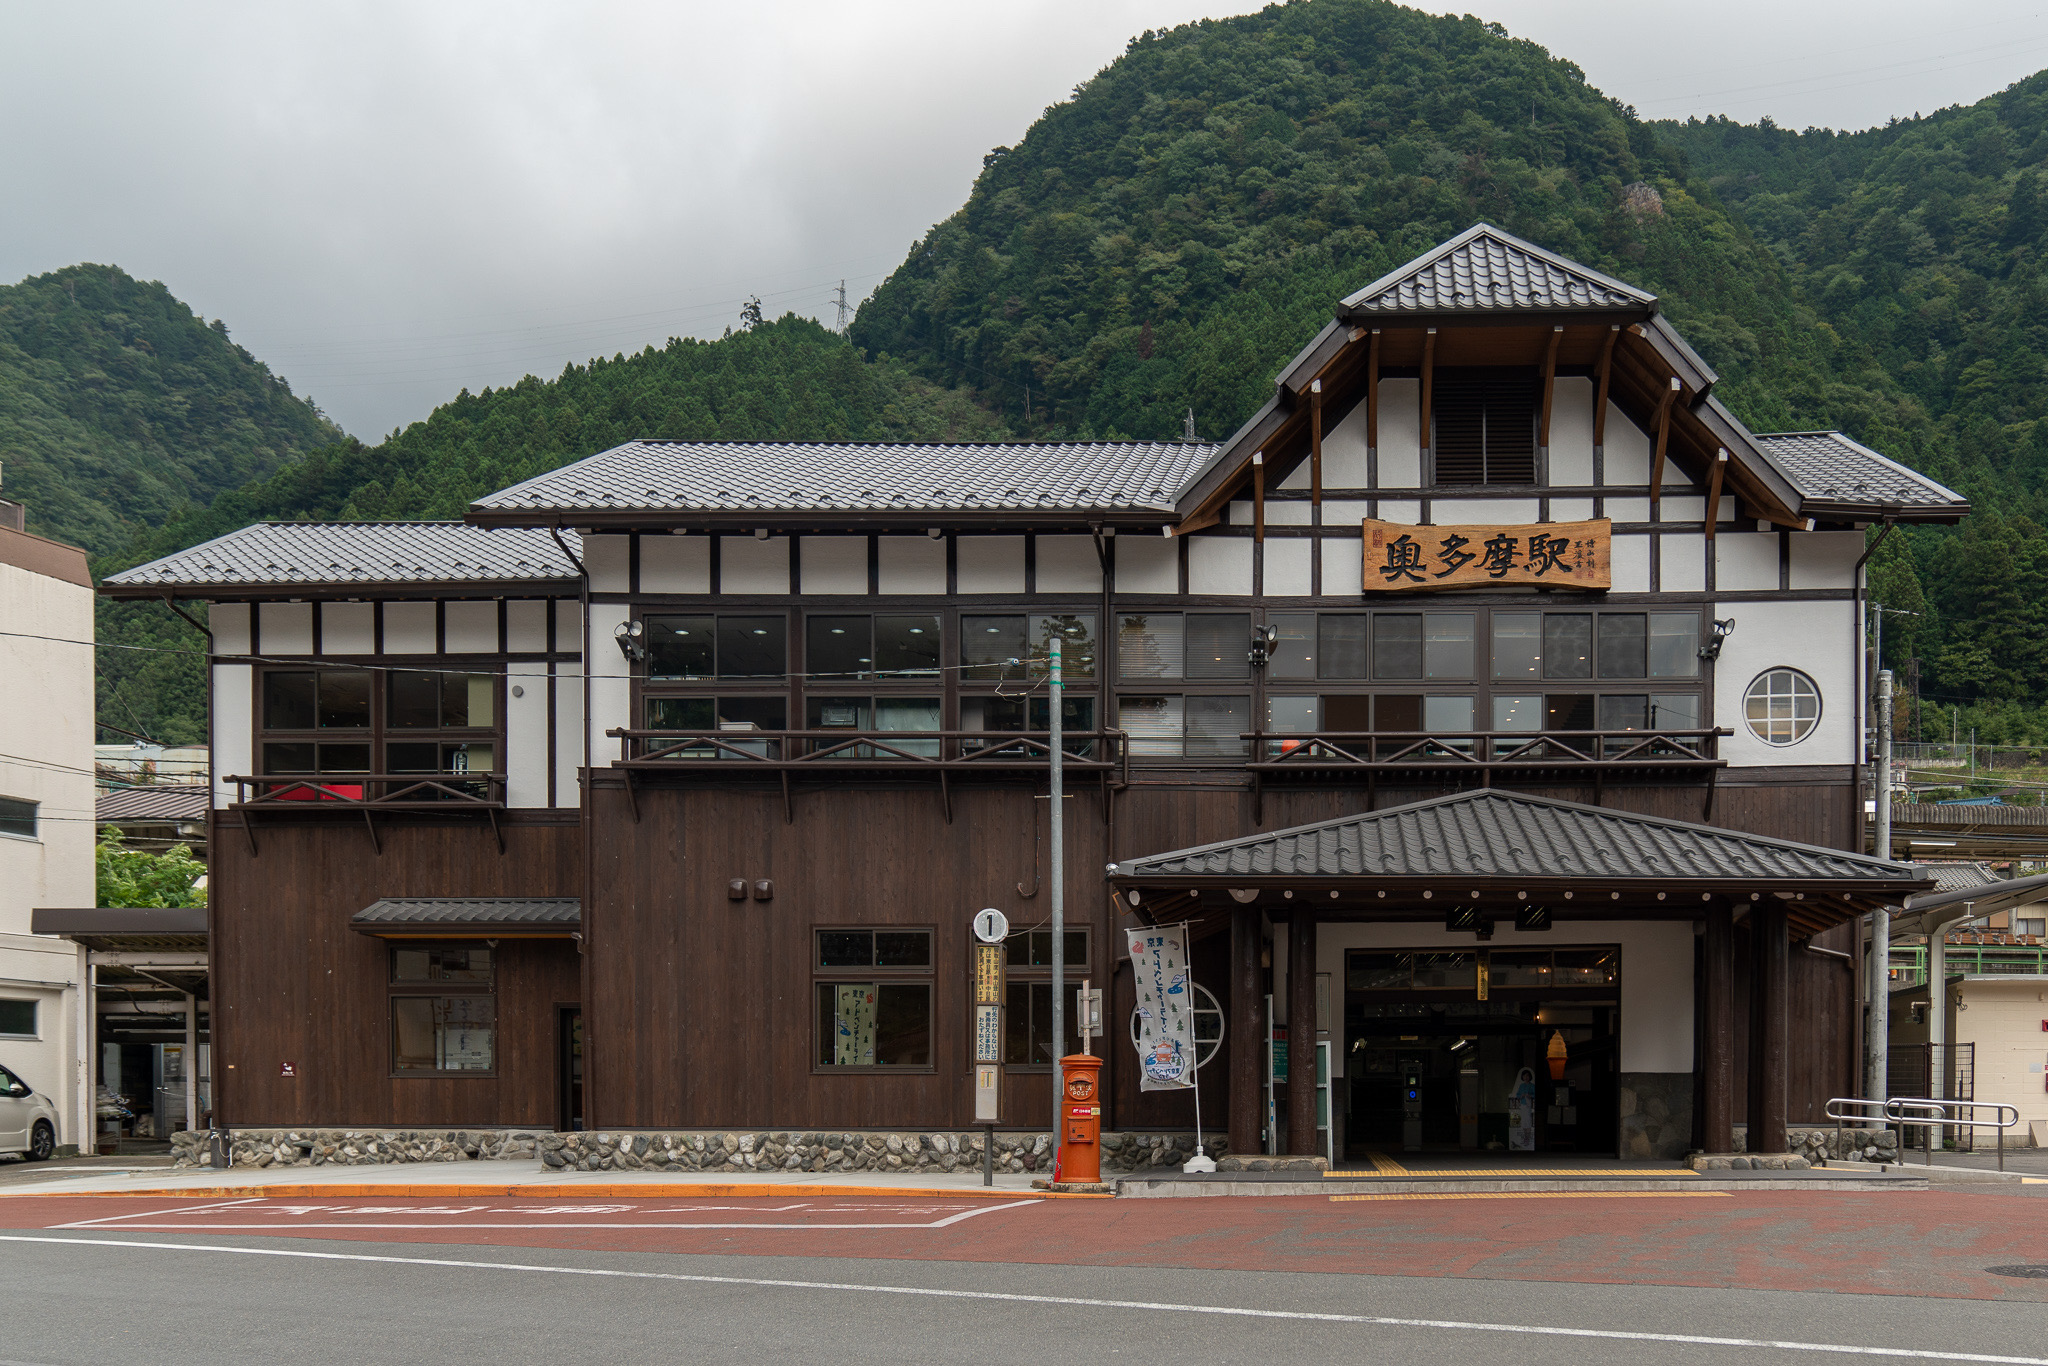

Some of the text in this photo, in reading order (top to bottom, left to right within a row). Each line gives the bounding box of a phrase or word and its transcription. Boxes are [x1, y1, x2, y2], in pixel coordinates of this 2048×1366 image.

[1379, 532, 1574, 583] 奥多摩駅
[986, 914, 993, 938] 1
[852, 989, 864, 998] 東京
